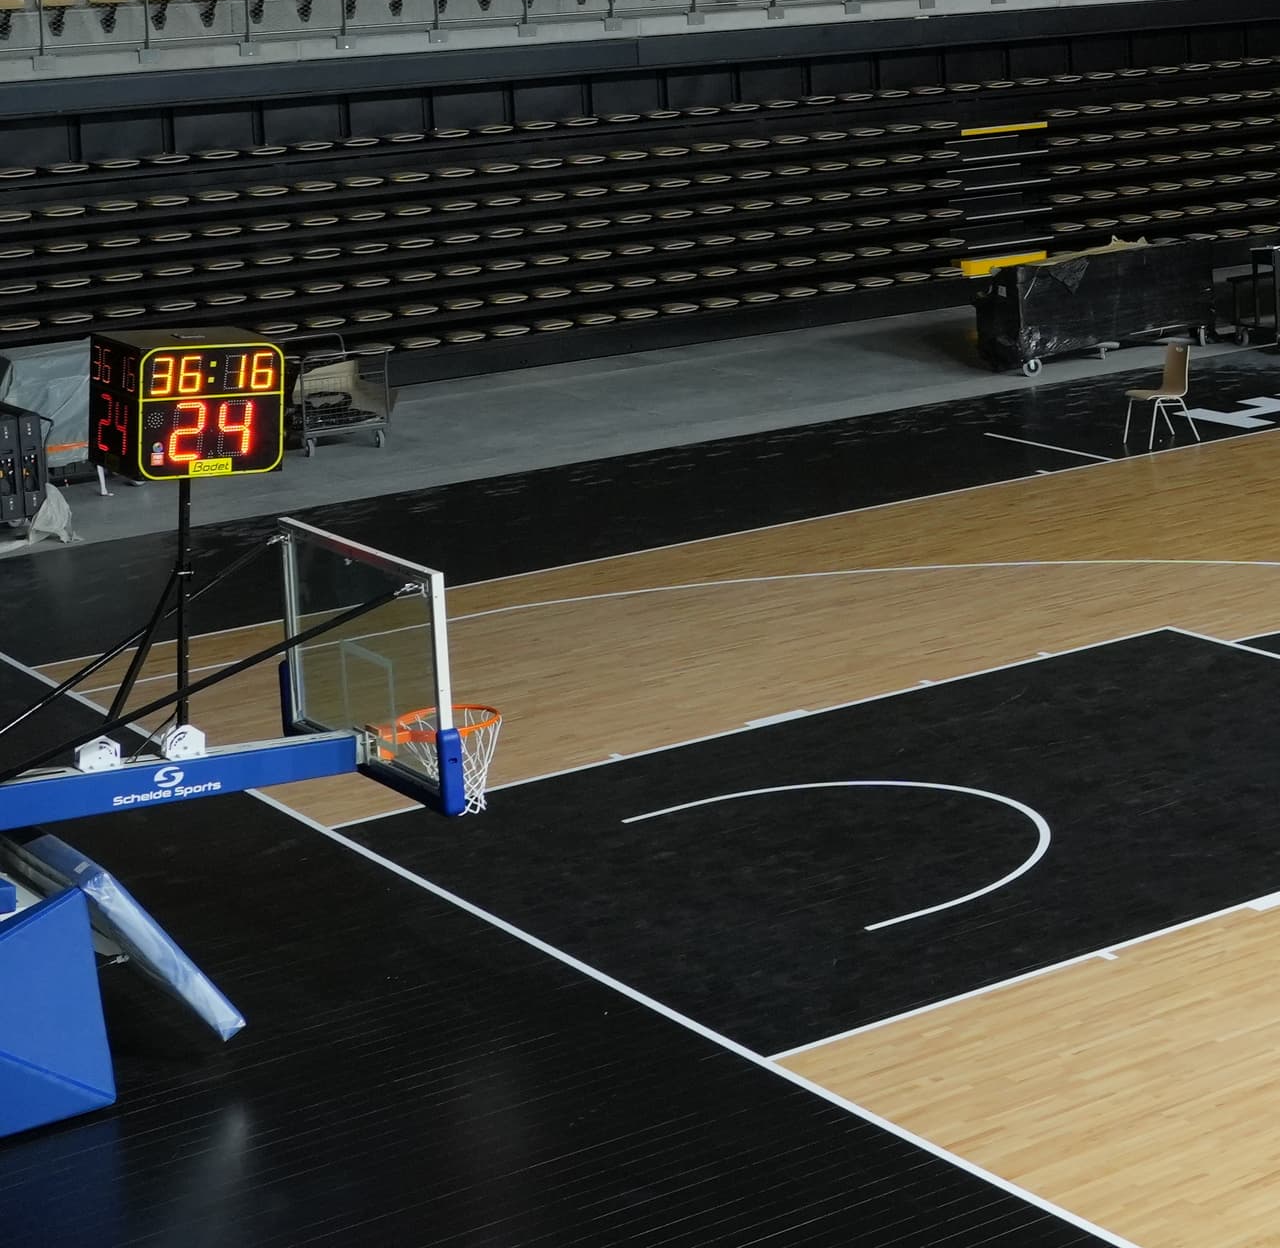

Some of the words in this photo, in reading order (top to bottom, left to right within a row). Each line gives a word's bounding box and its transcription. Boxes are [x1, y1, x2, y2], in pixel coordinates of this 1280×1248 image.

[151, 352, 274, 394] 36:16
[169, 401, 253, 461] 24
[192, 461, 229, 472] Bodet
[113, 789, 172, 806] Schelde
[174, 781, 222, 797] Sports
